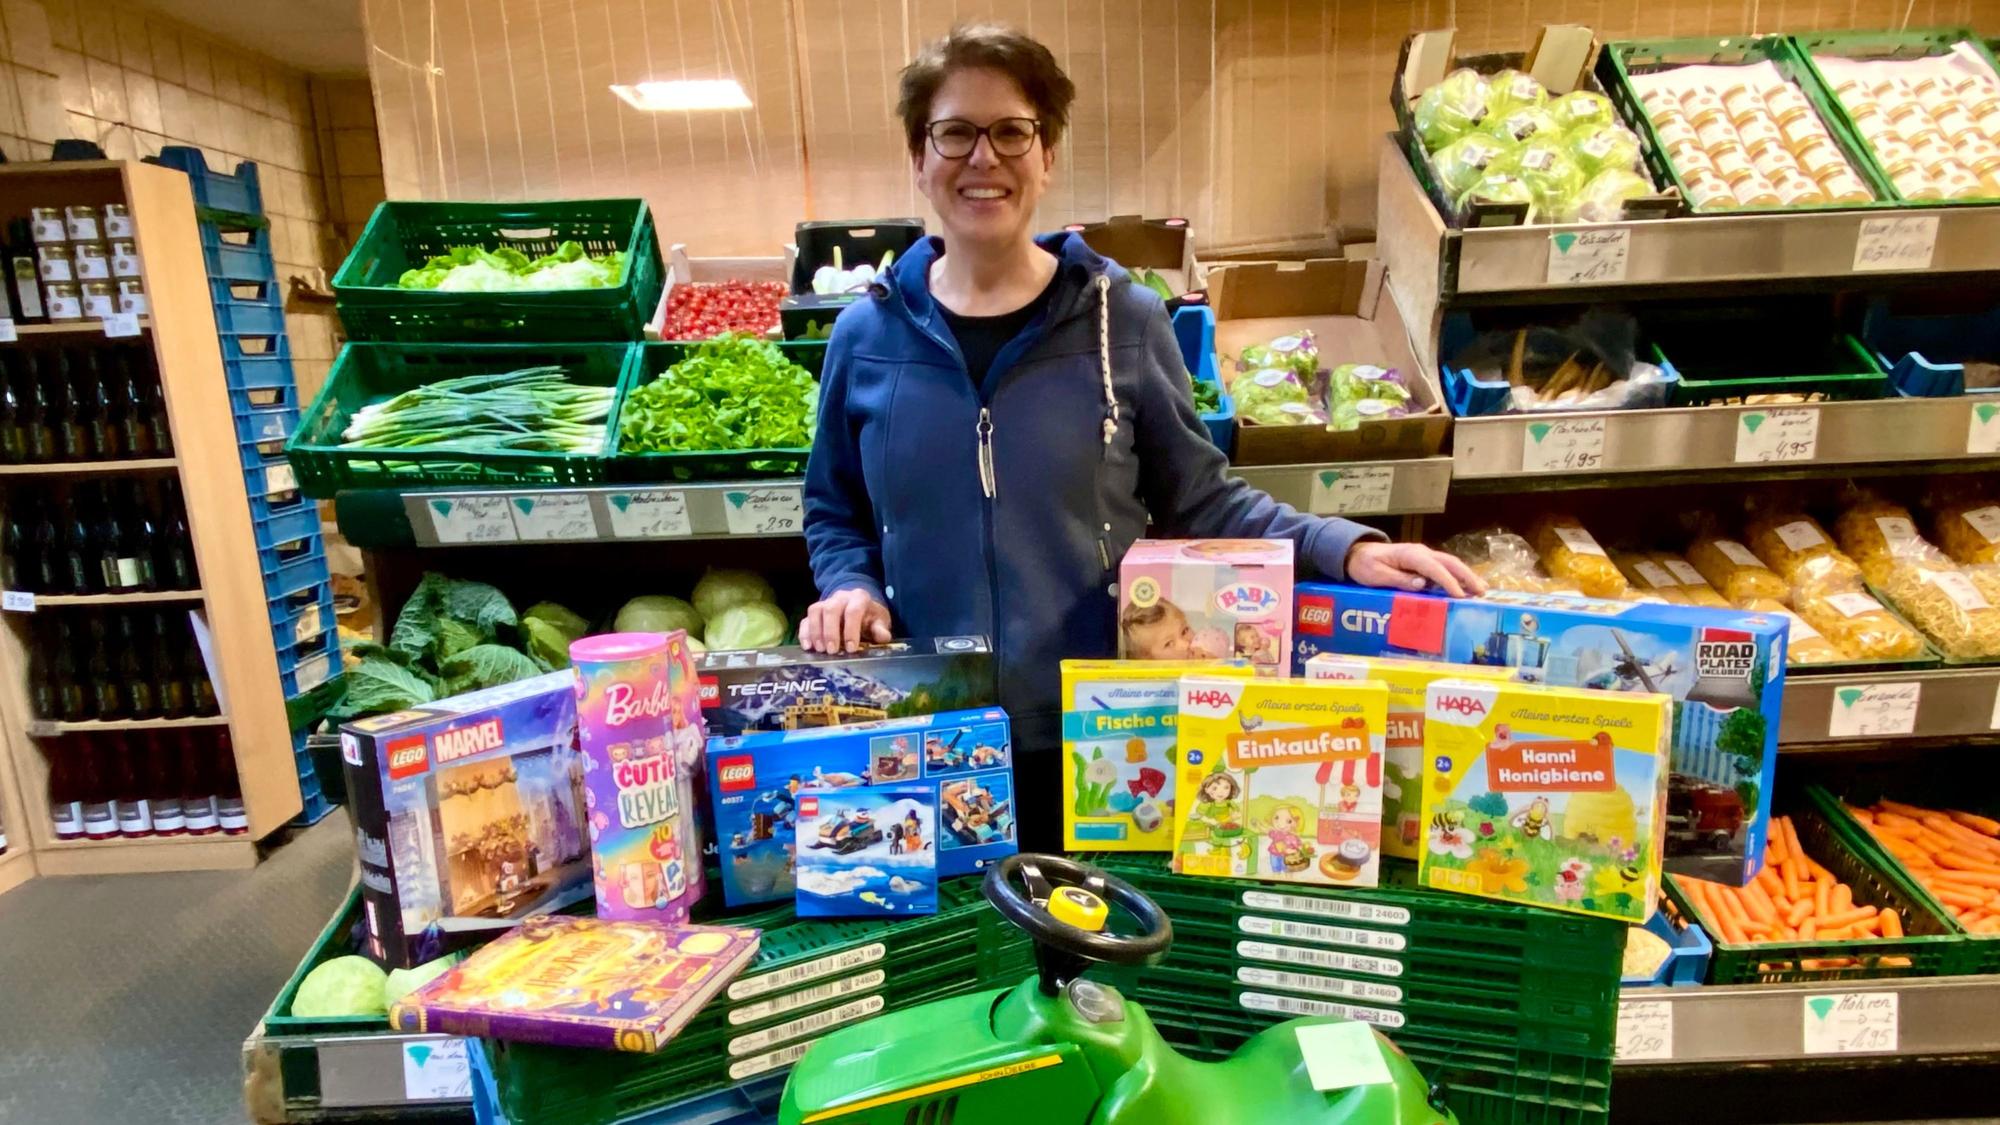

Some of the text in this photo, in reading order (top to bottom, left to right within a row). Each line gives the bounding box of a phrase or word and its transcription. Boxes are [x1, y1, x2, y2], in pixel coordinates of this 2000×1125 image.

[1220, 587, 1277, 608] BABY
[1300, 607, 1392, 635] LEGO CITY
[1298, 640, 1318, 655] 6+
[1699, 644, 1754, 658] ROAD
[1699, 659, 1751, 669] PLATES
[727, 679, 828, 697] TECHNIC
[1108, 688, 1142, 698] Meine
[606, 679, 671, 726] Barbi
[1188, 690, 1234, 708] HABA
[1256, 699, 1365, 714] Meine ersten Spiele
[1436, 696, 1486, 716] HABA
[1096, 713, 1156, 731] Fische
[1511, 708, 1633, 728] Meine ersten Spiele
[391, 720, 503, 768] LEGO MARVEL
[1237, 732, 1362, 759] Einkaufen
[1188, 753, 1201, 762] 2+
[1437, 759, 1450, 769] 2+
[1522, 749, 1577, 764] Hanni
[722, 765, 753, 781] LEGO
[1498, 768, 1605, 785] Honigbiene
[620, 784, 677, 824] REVEAL
[1375, 909, 1405, 920] 24603
[1377, 936, 1395, 946] 216
[1837, 993, 1892, 1011] Möhren
[1382, 1014, 1400, 1024] 216
